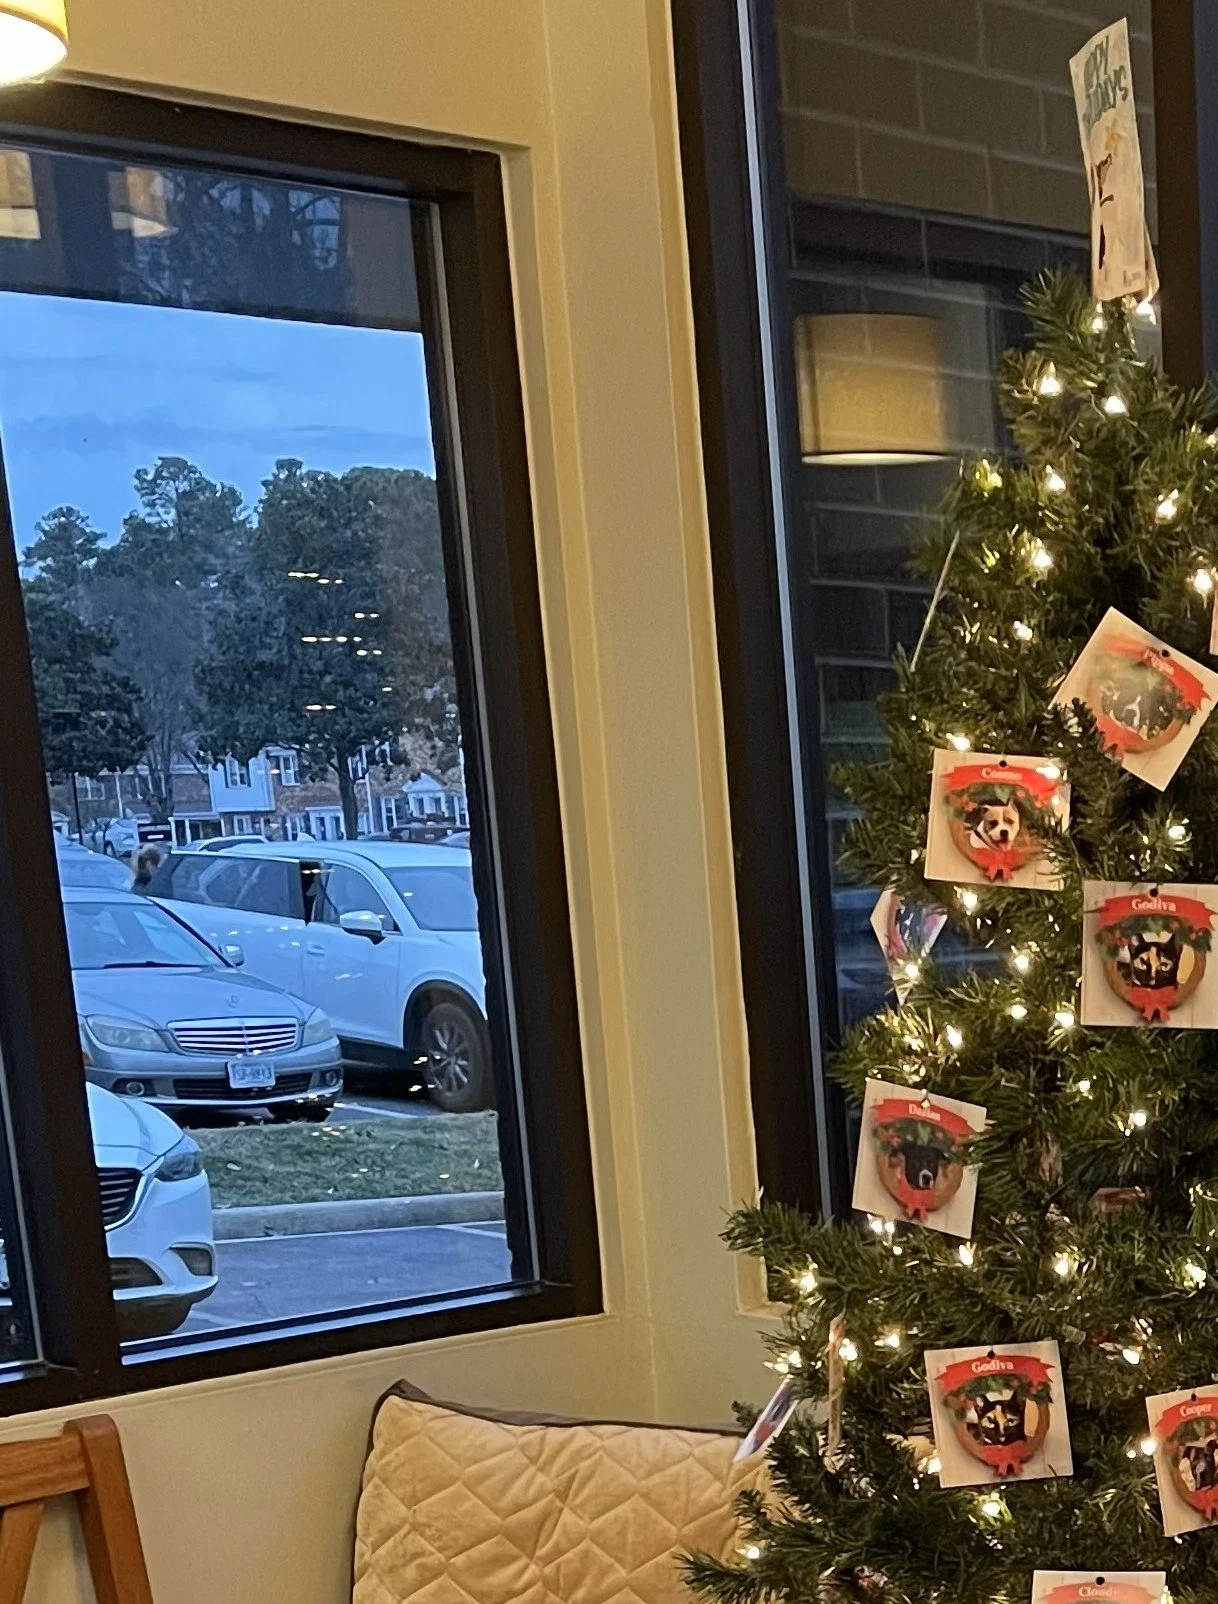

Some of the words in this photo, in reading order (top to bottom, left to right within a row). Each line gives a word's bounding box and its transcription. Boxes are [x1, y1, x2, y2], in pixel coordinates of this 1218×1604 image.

[1132, 898, 1176, 911] Godiva
[971, 1359, 1014, 1373] Godiva
[1180, 1404, 1212, 1417] Cooper
